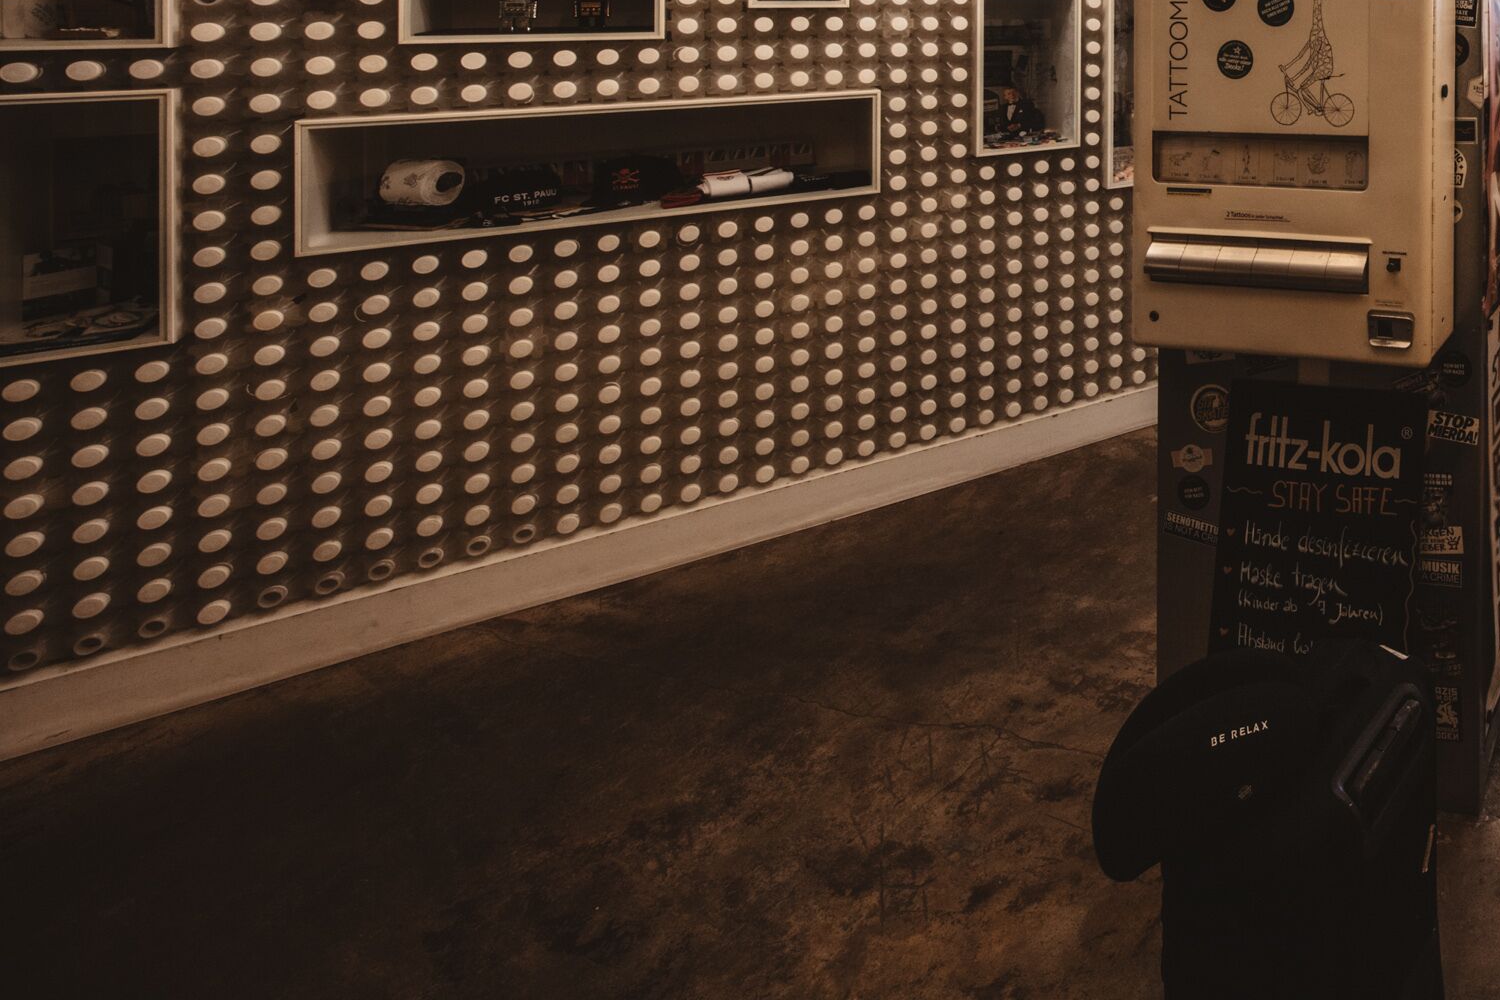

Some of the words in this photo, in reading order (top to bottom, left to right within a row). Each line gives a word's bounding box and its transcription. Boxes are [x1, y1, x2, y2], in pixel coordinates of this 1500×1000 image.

[494, 195, 510, 204] FC
[513, 192, 531, 202] ST.
[534, 188, 557, 199] PAULI
[1433, 412, 1475, 429] STOP
[1428, 424, 1479, 444] MIERDA!
[1244, 411, 1402, 480] fritz-kola
[1267, 480, 1328, 513] STAY
[1335, 483, 1398, 515] SAFE
[1167, 511, 1219, 536] SEENOTRETTU
[1201, 532, 1218, 546] CRI
[1298, 525, 1409, 568] desinfizieren
[1422, 561, 1461, 574] MUSIK
[1240, 560, 1283, 588] Maske
[1291, 560, 1348, 606] tragen
[1283, 597, 1298, 612] ab
[1210, 732, 1226, 747] BE
[1231, 719, 1269, 740] RELAX
